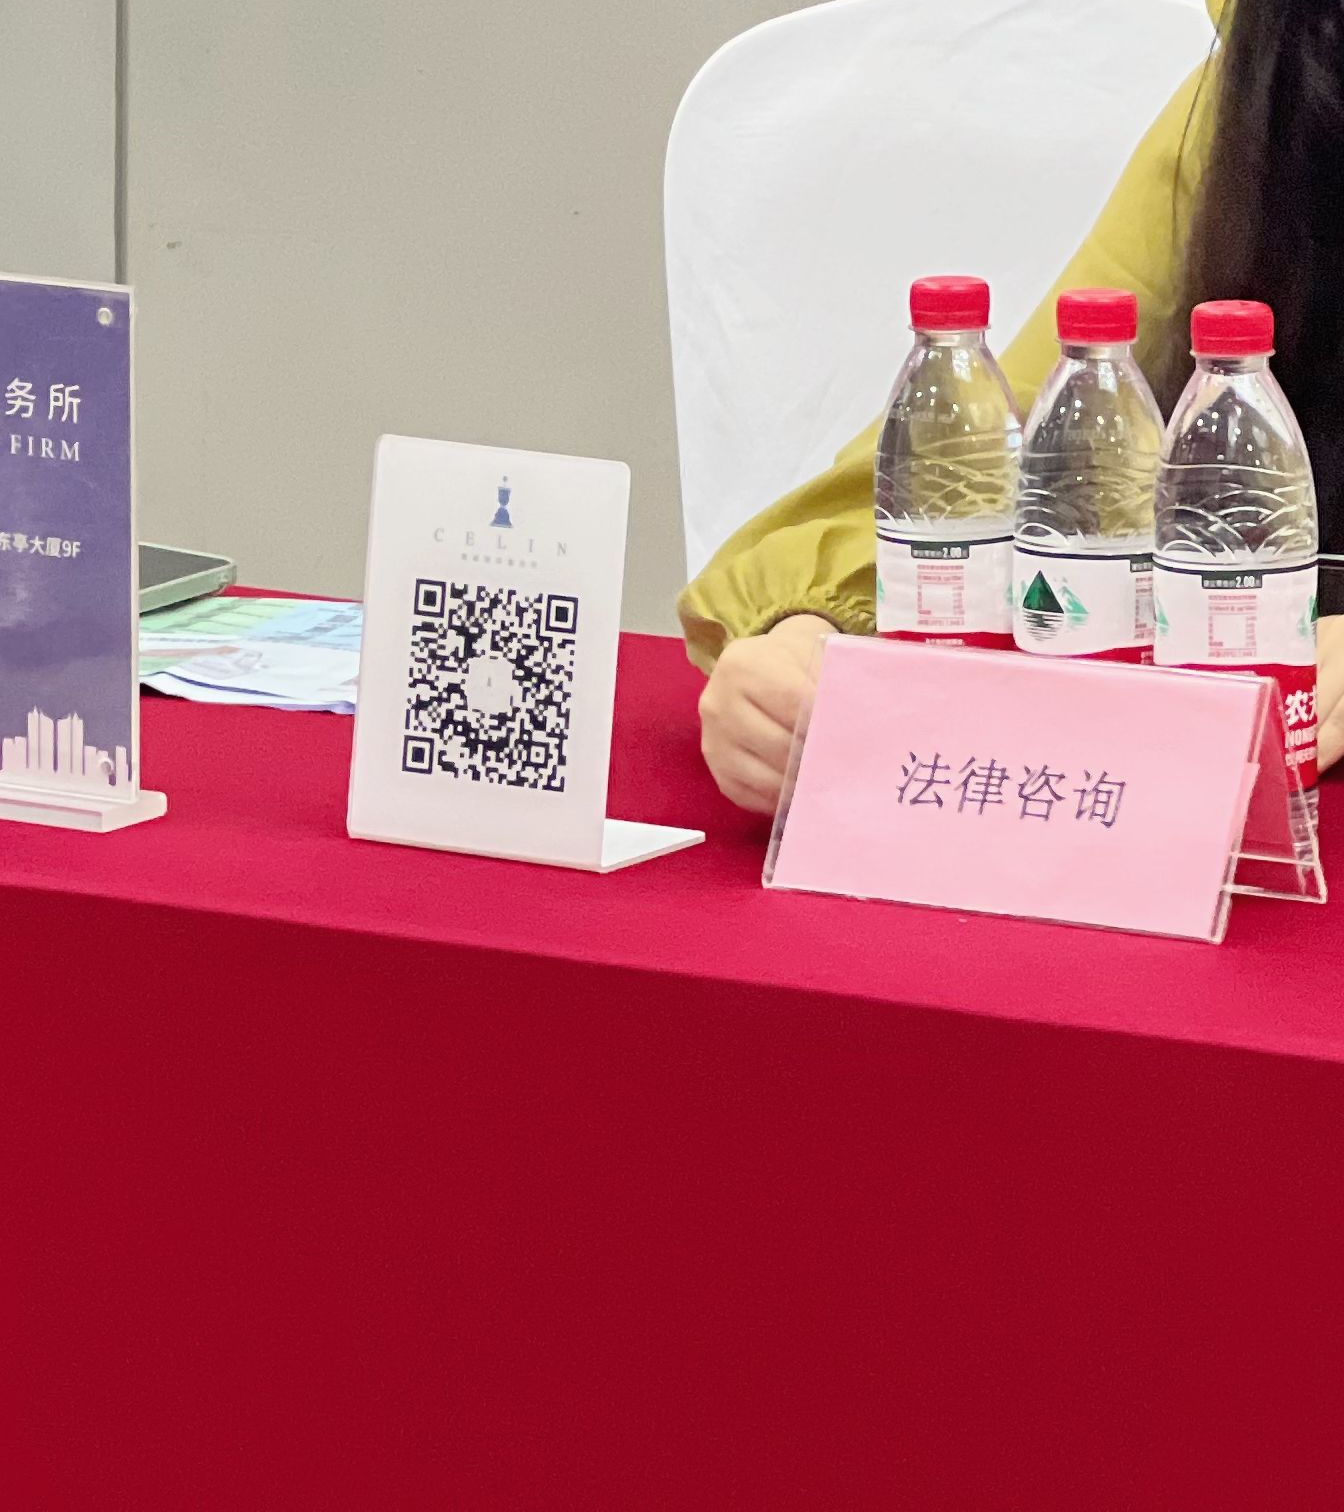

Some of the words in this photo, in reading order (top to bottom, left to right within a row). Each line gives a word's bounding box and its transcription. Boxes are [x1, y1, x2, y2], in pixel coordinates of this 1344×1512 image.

[10, 433, 81, 462] FIRM
[433, 527, 568, 557] CELIN
[895, 750, 1127, 829] 法律咨询
